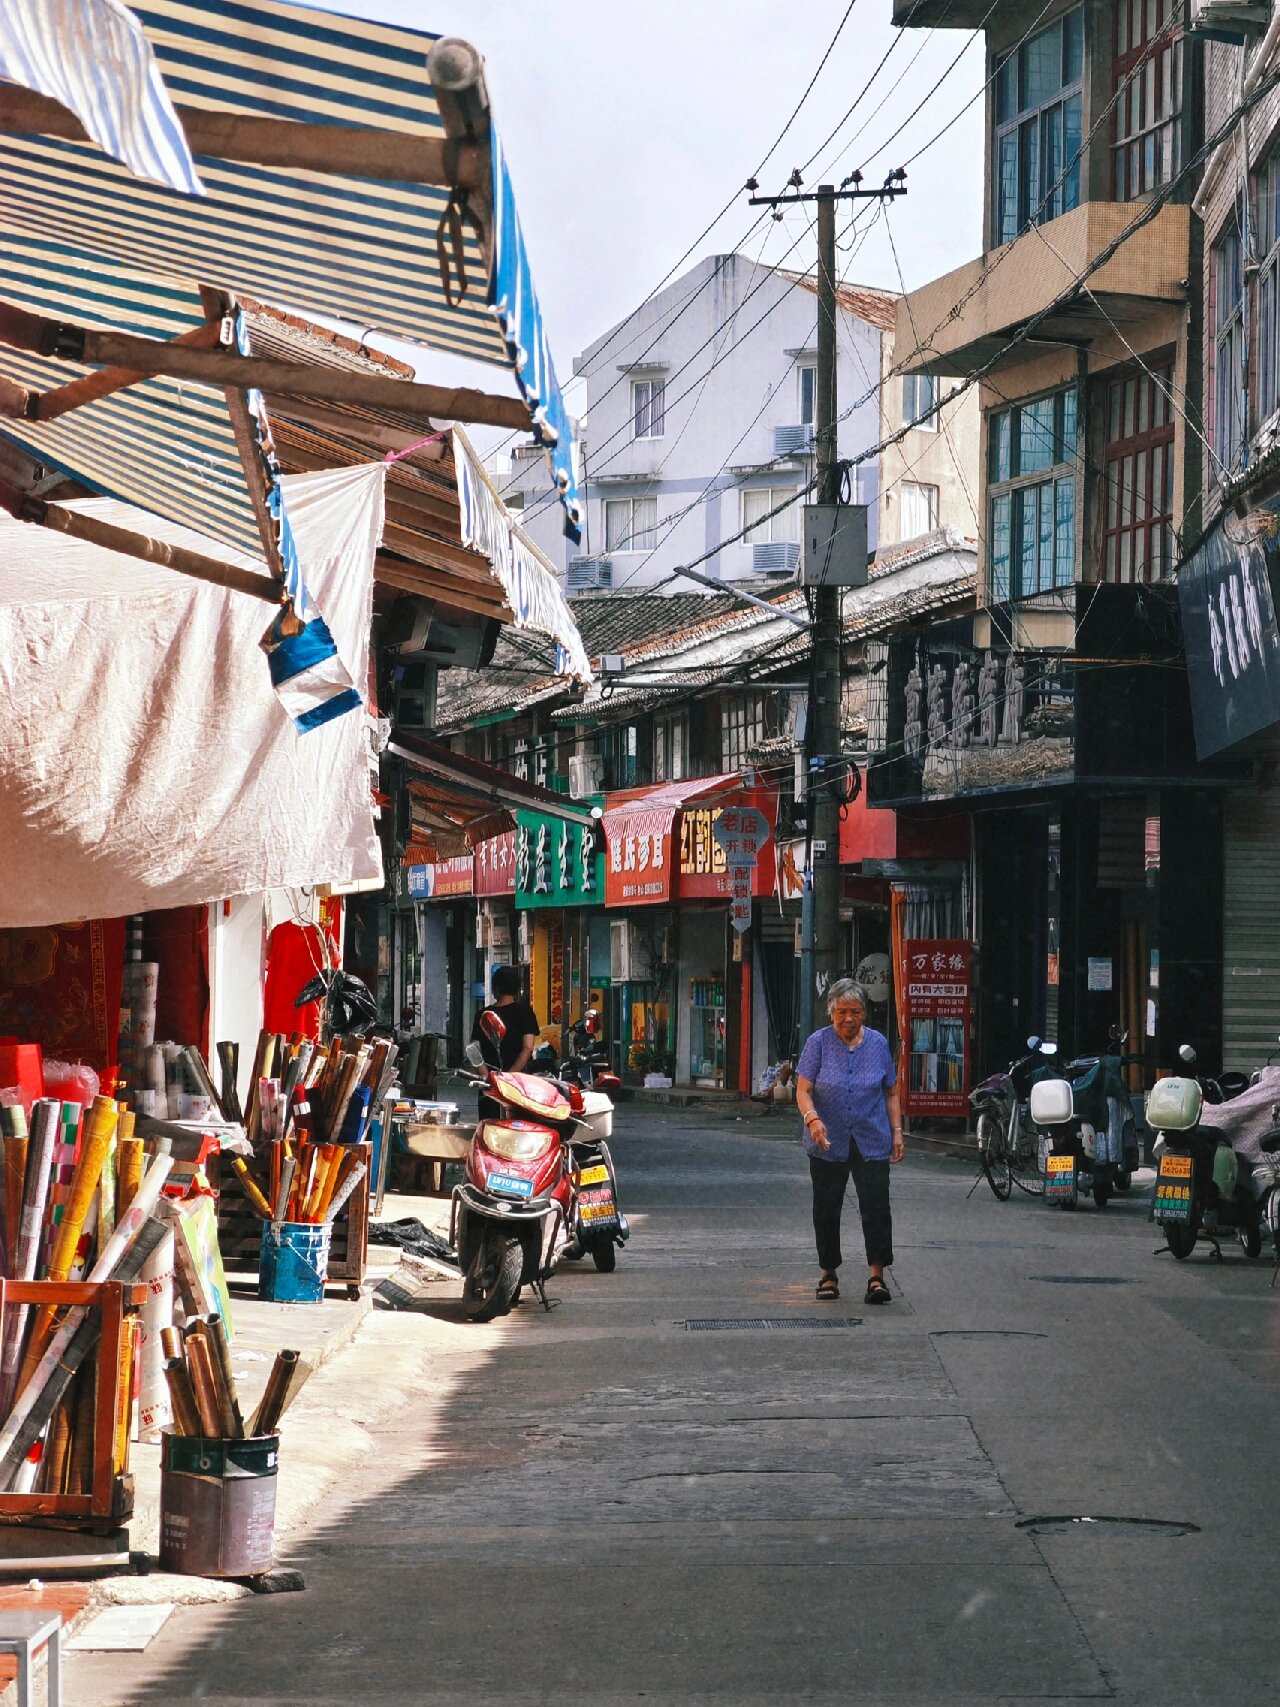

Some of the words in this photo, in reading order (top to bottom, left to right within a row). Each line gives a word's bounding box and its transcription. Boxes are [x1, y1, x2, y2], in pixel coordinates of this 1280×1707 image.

[722, 812, 759, 834] 老店
[725, 838, 758, 855] 开锁
[911, 951, 966, 972] 万家缘
